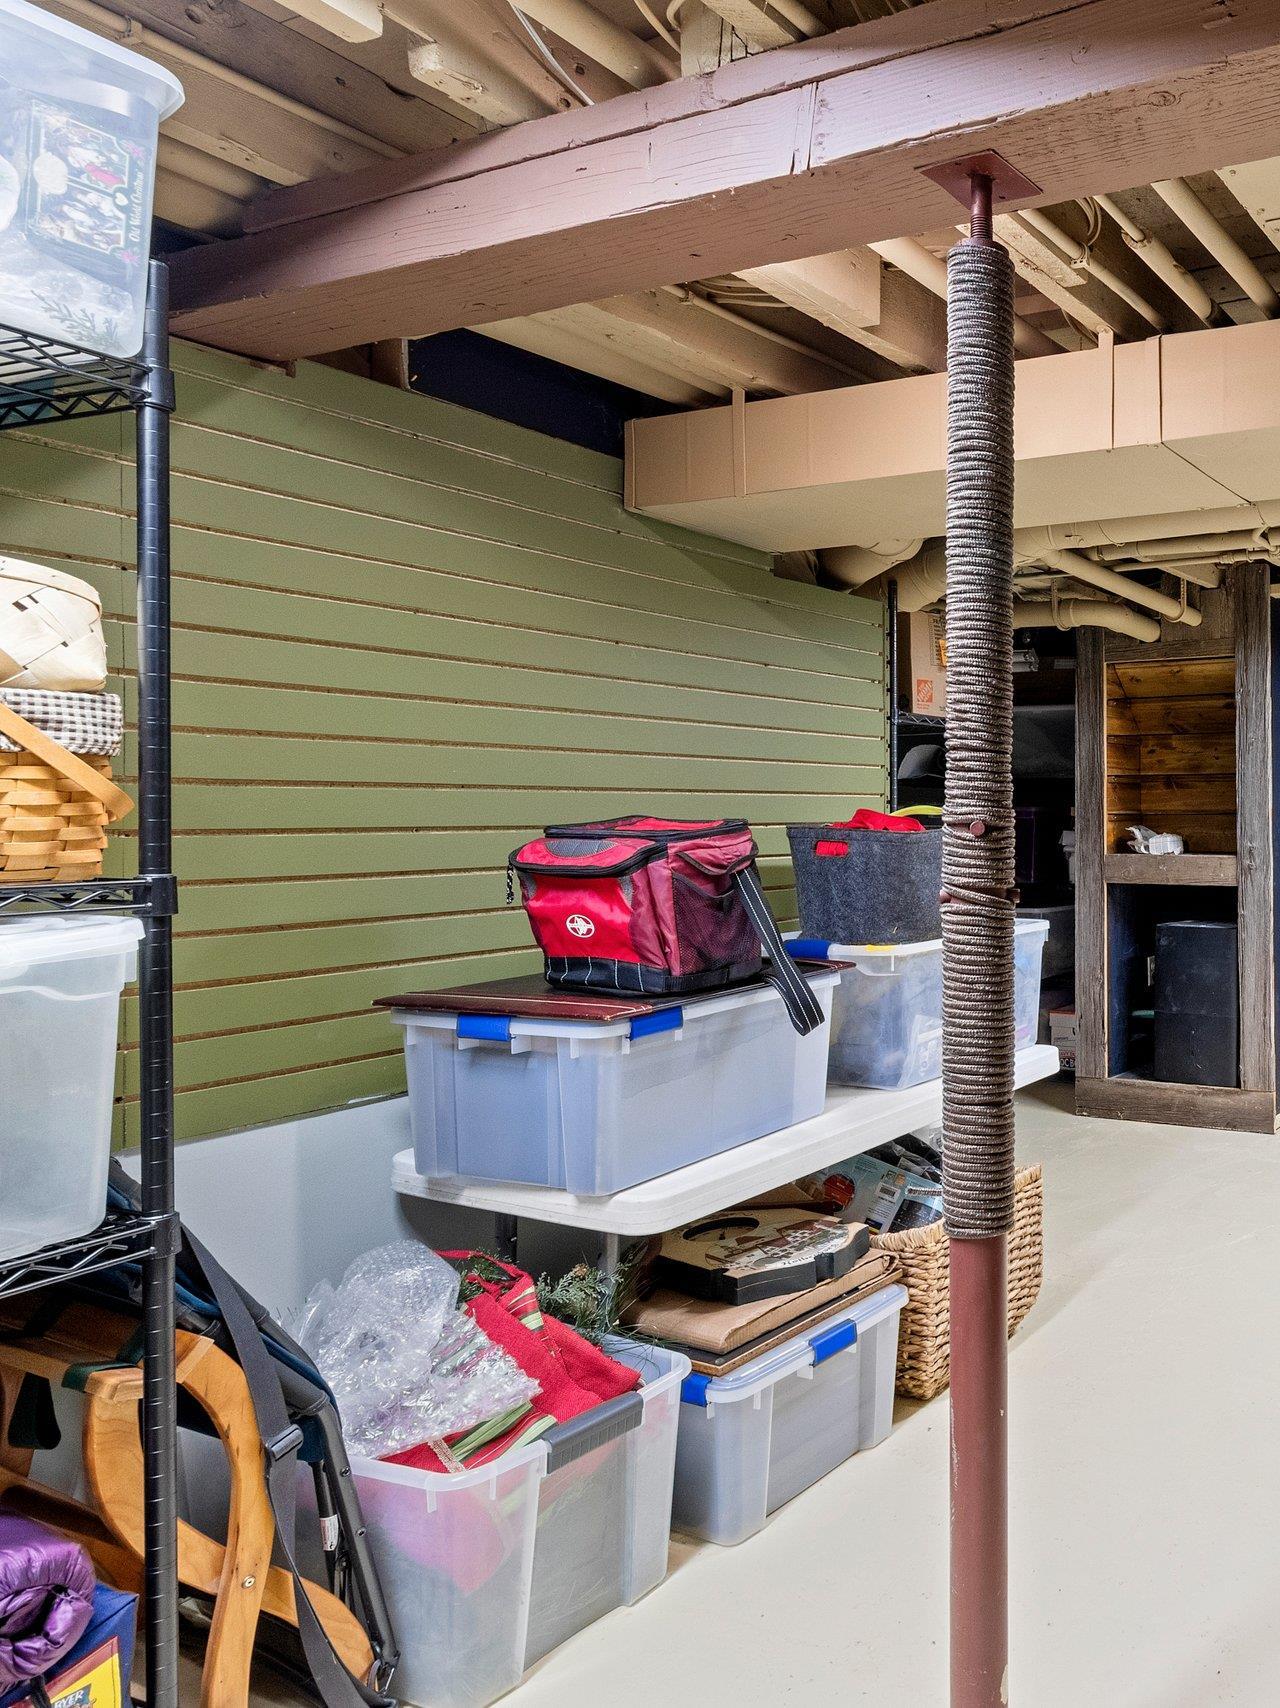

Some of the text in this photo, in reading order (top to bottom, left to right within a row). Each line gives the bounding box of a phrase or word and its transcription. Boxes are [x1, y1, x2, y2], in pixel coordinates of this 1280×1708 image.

[128, 172, 144, 241] Old World Christmas
